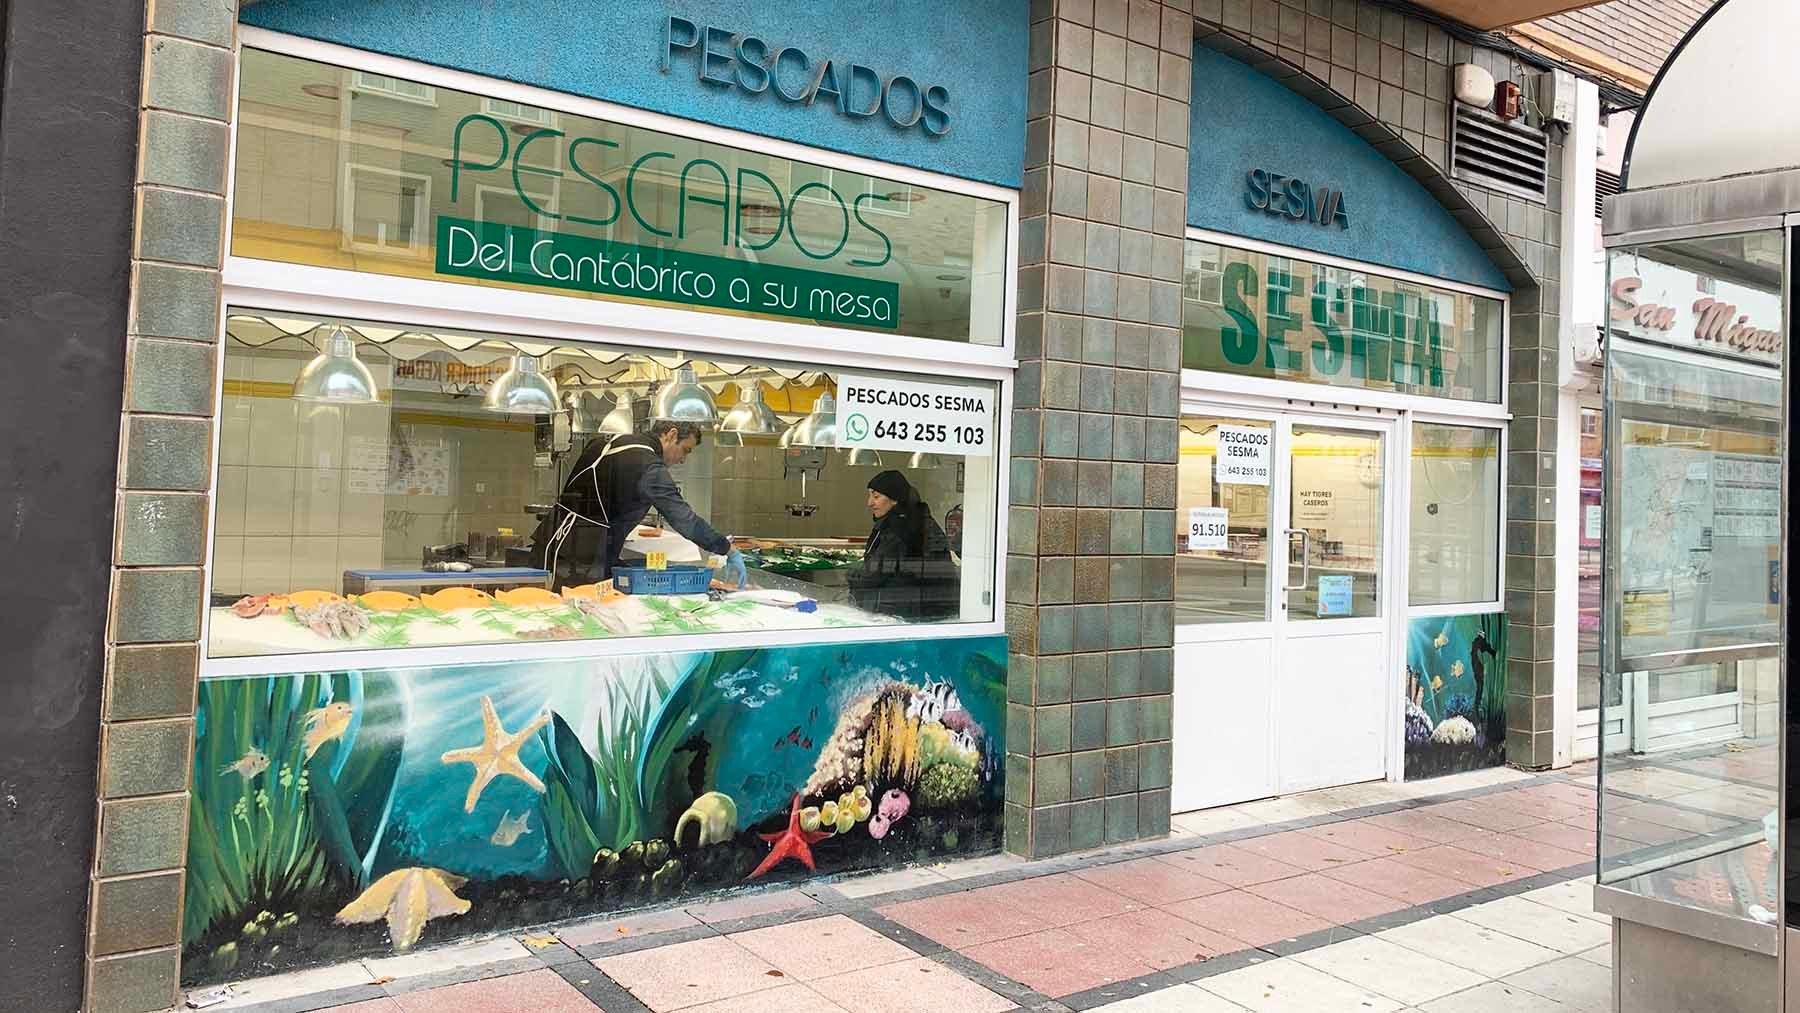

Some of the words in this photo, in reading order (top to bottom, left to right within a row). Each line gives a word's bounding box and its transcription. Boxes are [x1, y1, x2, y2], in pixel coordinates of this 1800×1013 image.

[663, 16, 950, 136] PESCADOS
[451, 114, 893, 267] PESCADOS
[1246, 168, 1349, 230] SESMA
[448, 226, 514, 273] Del
[530, 239, 716, 298] Cantábrico
[729, 278, 750, 303] a
[763, 282, 798, 309] su
[809, 288, 891, 321] mesa
[1611, 277, 1677, 331] San
[1221, 262, 1444, 387] SESMA
[847, 387, 930, 409] PESCADOS
[935, 395, 985, 413] SESMA
[874, 420, 908, 440] 643
[914, 423, 946, 442] 255
[953, 426, 984, 445] 103
[1219, 431, 1268, 446] PESCADOS
[1227, 446, 1259, 459] SESMA
[1228, 466, 1240, 475] 643
[1242, 467, 1254, 476] 255
[1256, 468, 1267, 477] 103
[1300, 490, 1311, 498] HAY
[1312, 491, 1332, 499] TIGRES
[1192, 523, 1226, 537] 91.510
